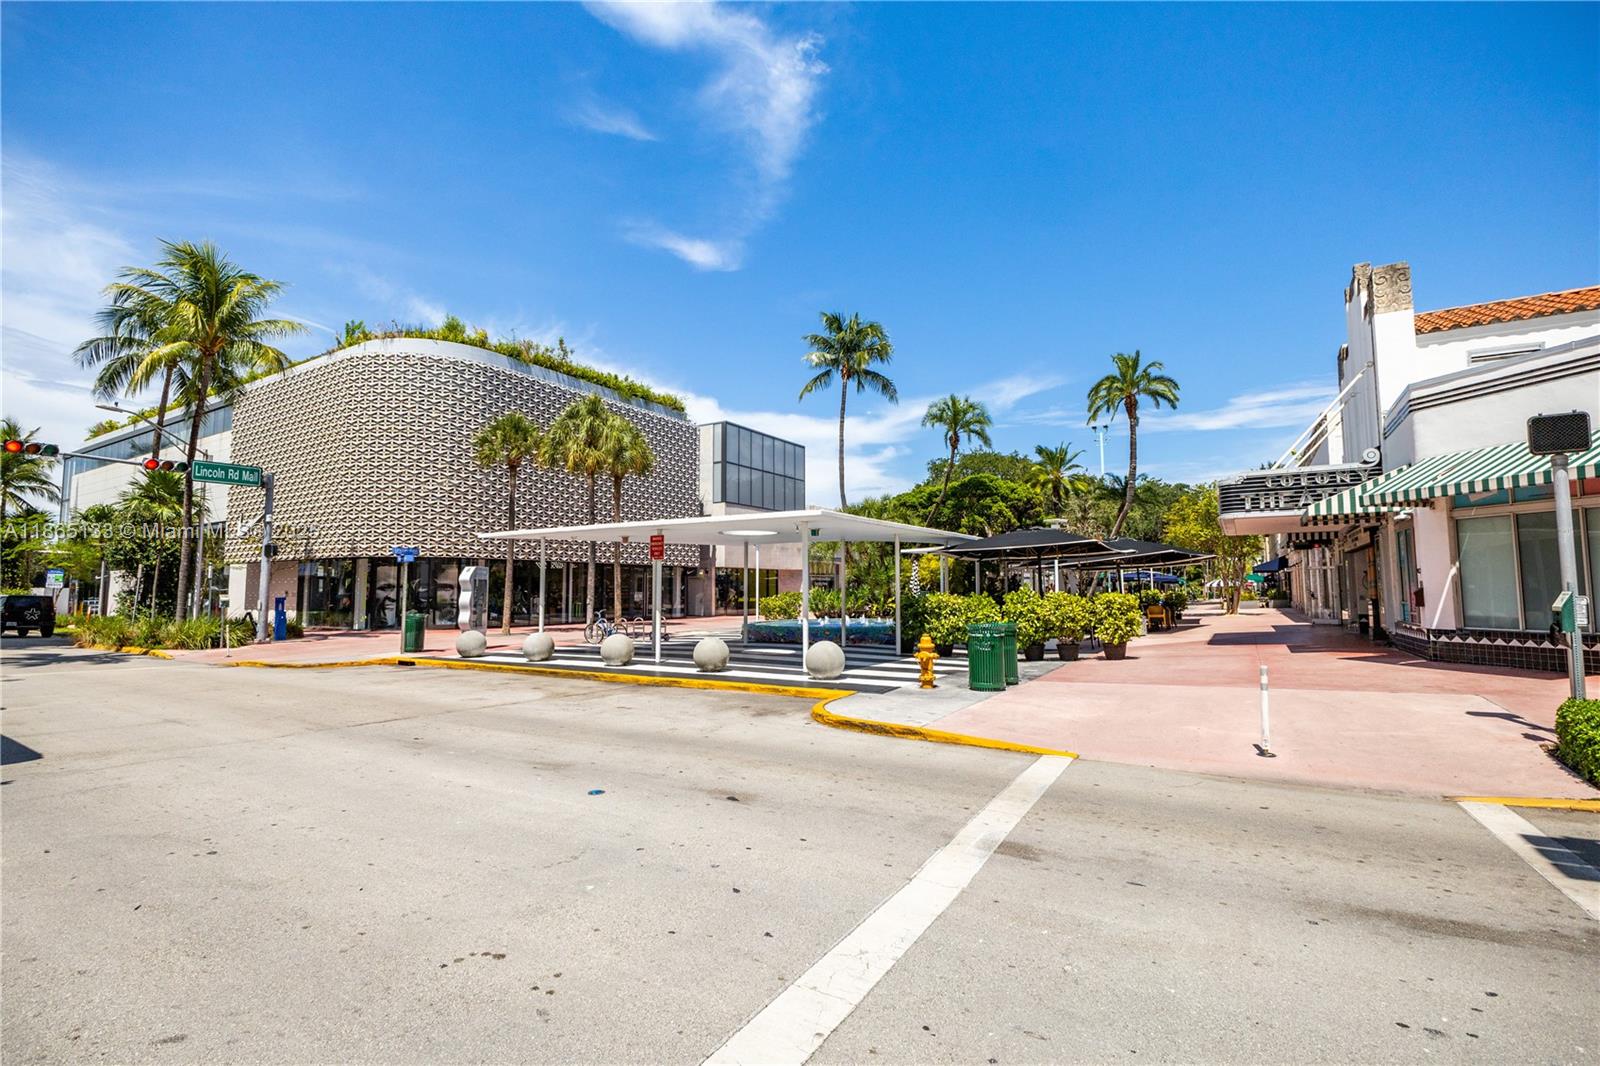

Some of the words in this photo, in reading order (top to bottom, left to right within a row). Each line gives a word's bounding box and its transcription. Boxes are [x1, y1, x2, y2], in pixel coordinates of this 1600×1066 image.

[195, 465, 225, 479] Lincoln
[228, 469, 239, 480] Rd
[242, 470, 258, 481] Mall
[1265, 469, 1370, 488] COLONY
[1240, 486, 1343, 510] THEAT
